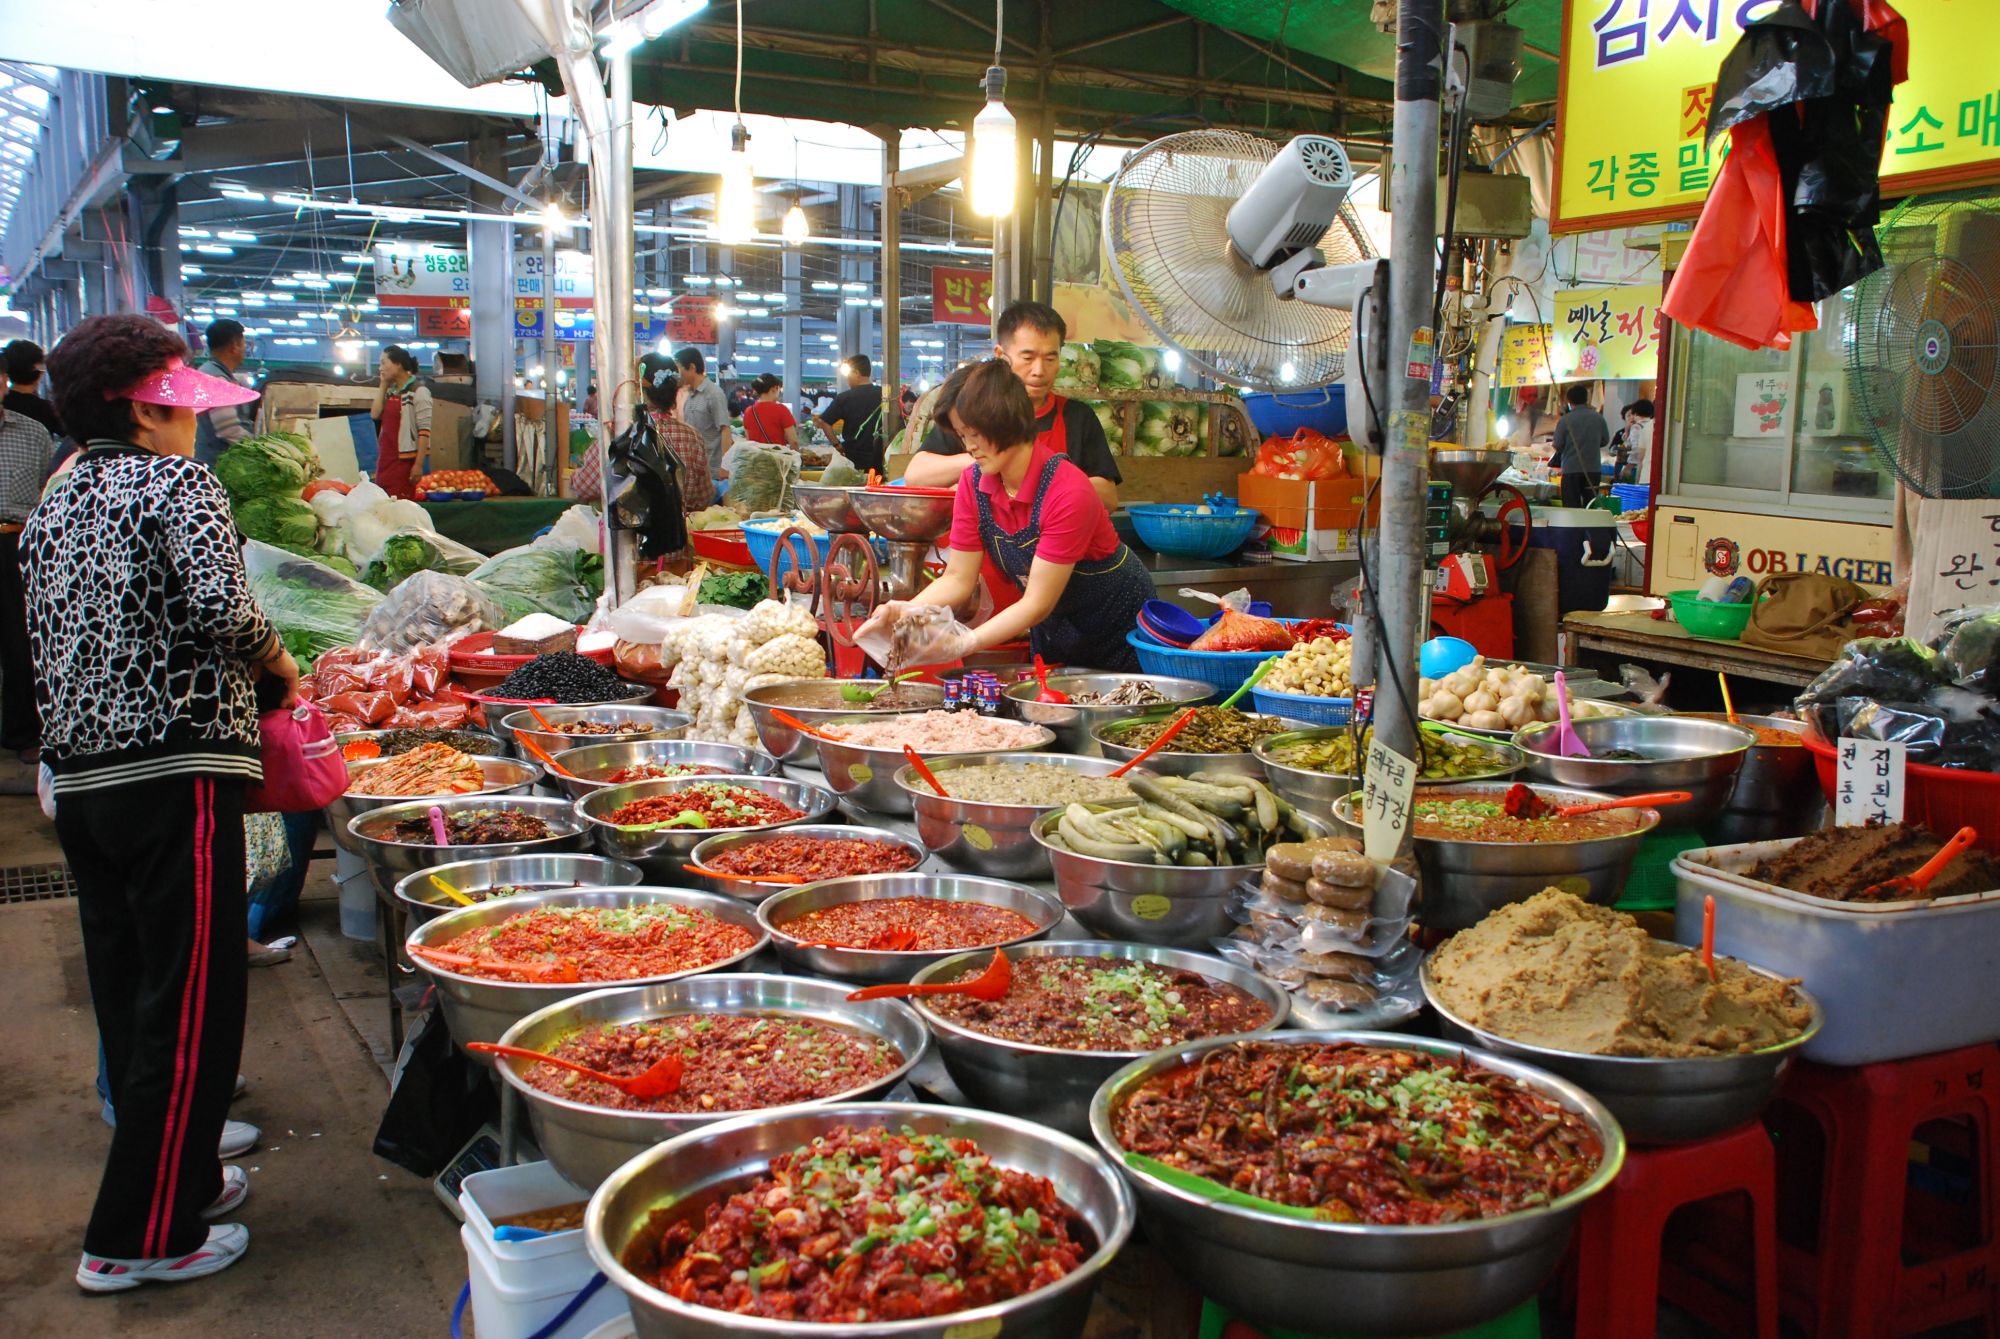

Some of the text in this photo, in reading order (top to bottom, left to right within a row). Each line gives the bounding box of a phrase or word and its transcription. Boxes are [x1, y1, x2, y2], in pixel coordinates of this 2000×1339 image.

[1586, 152, 1660, 201] 각종
[517, 278, 575, 293] 판매니다
[1567, 299, 1615, 344] 옛날
[1746, 548, 1893, 587] OB LAGER
[1939, 552, 2000, 592] 완
[1838, 742, 1857, 804] 전통
